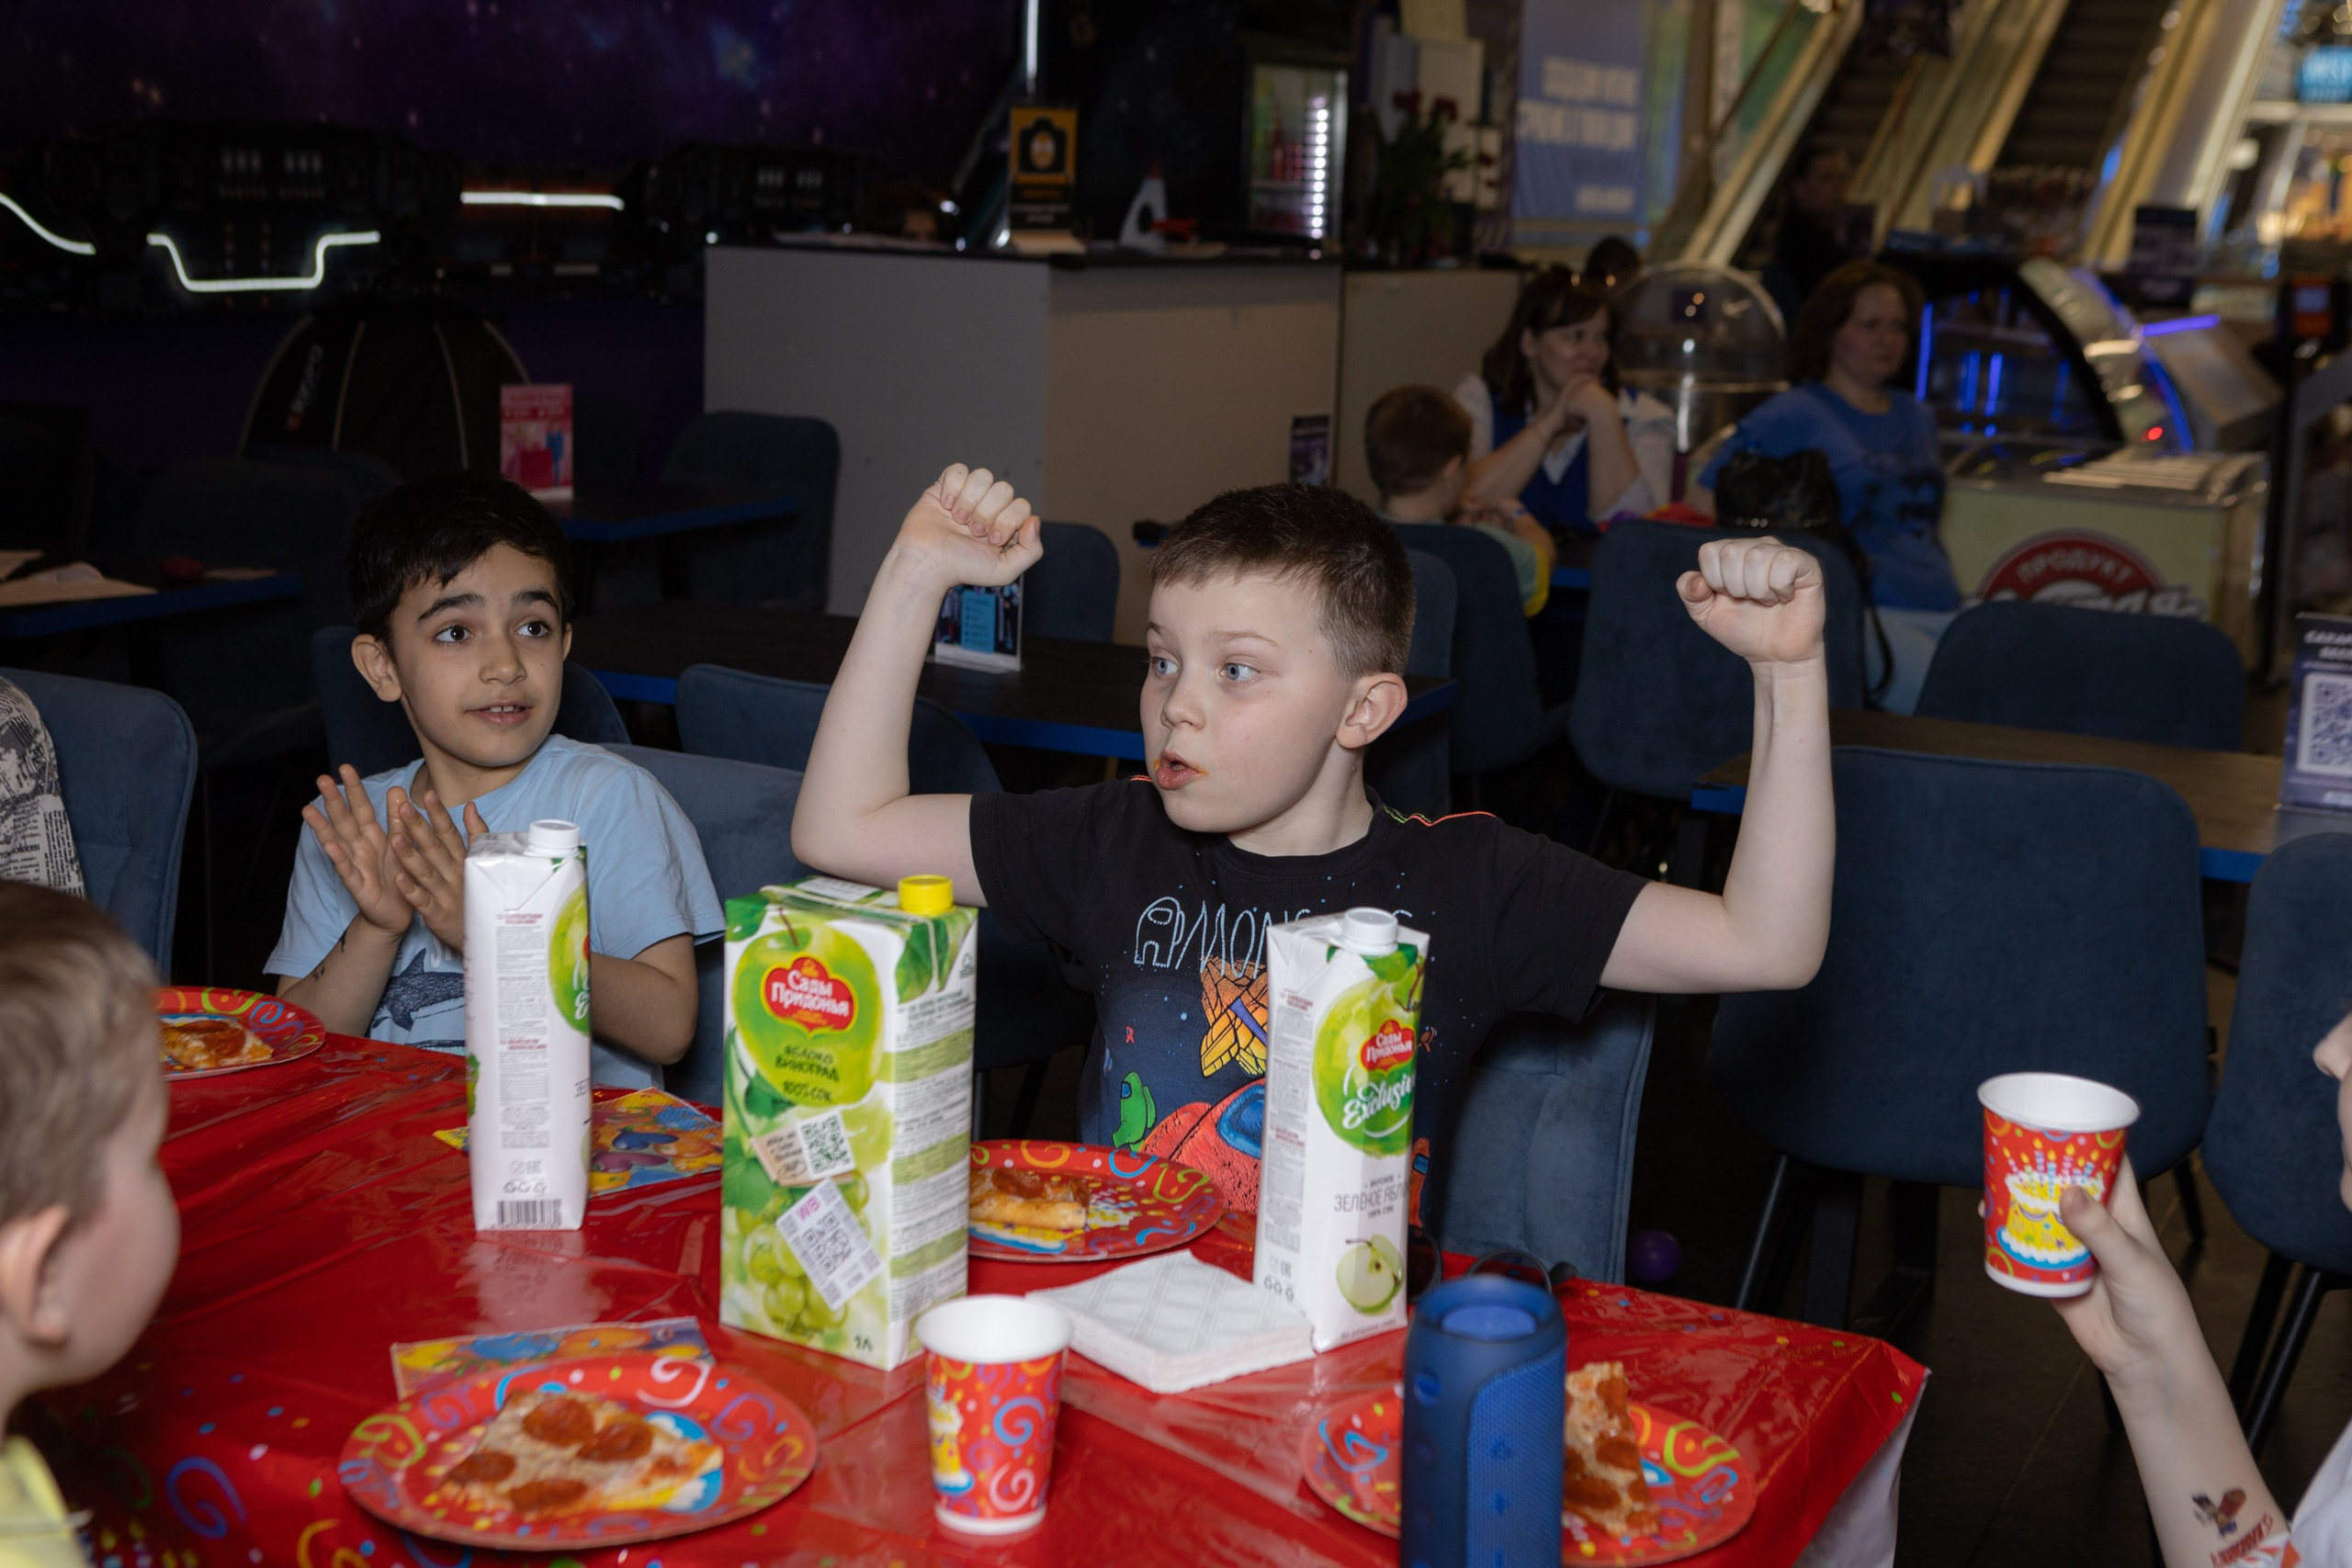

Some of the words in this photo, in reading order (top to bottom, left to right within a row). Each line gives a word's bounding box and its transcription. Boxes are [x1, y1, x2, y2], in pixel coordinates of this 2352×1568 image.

[787, 969, 833, 998] Сады
[771, 981, 850, 1018] Придонья
[1366, 1041, 1413, 1064] Придонья
[1375, 1032, 1403, 1049] Сады
[784, 1043, 834, 1066] ЯБЛОКО
[775, 1055, 840, 1082] ВИНОГРАД
[1341, 1070, 1416, 1130] Exclusiv
[795, 1195, 820, 1223] WB
